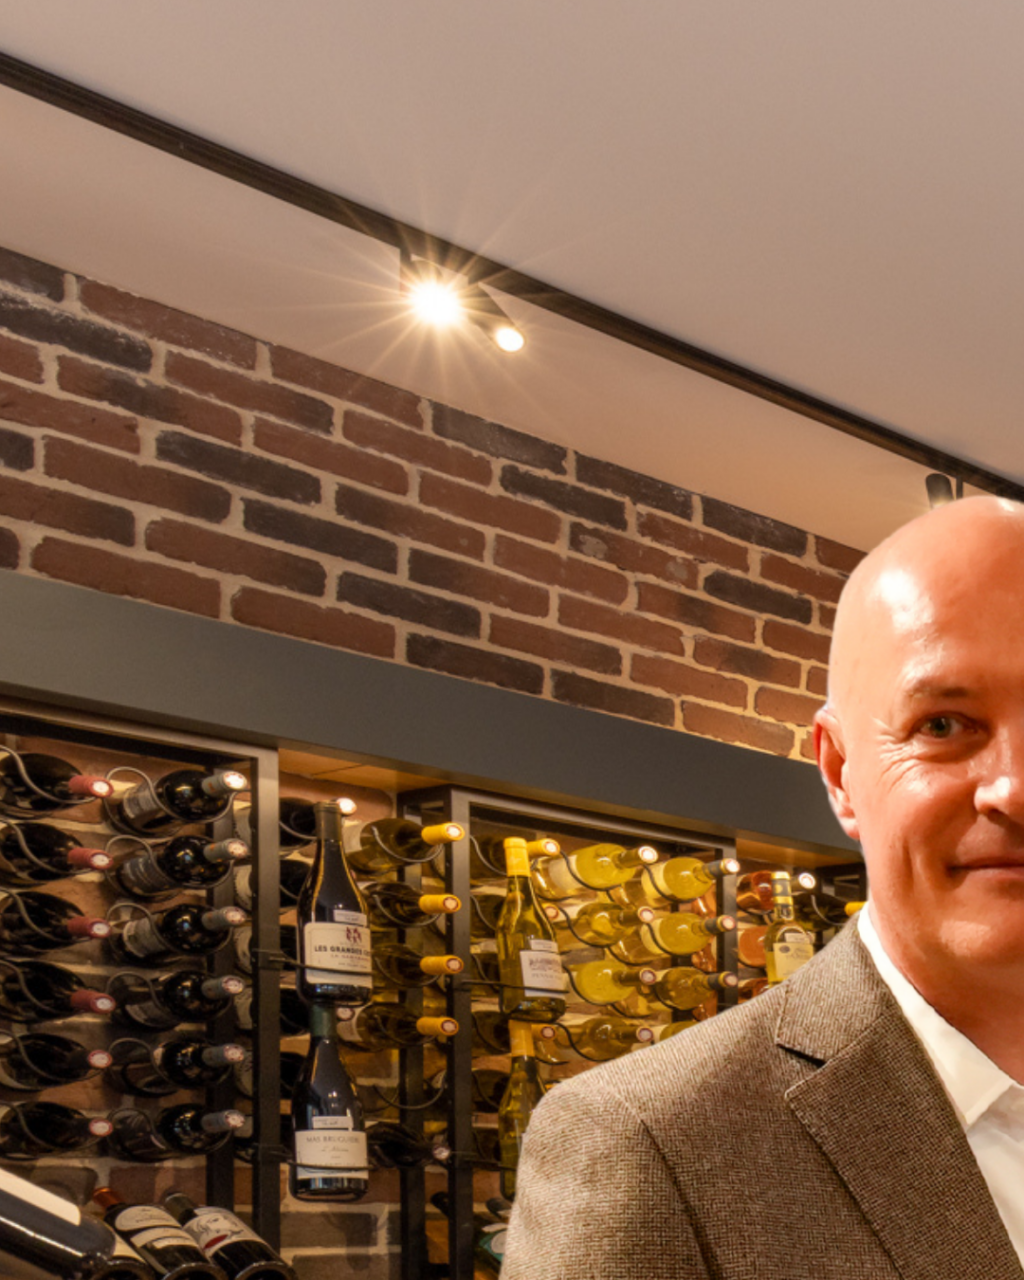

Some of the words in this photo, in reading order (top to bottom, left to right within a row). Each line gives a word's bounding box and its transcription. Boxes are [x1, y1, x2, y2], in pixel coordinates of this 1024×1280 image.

[314, 945, 328, 953] LES
[329, 946, 363, 956] GRANDES
[306, 1135, 321, 1143] MAS
